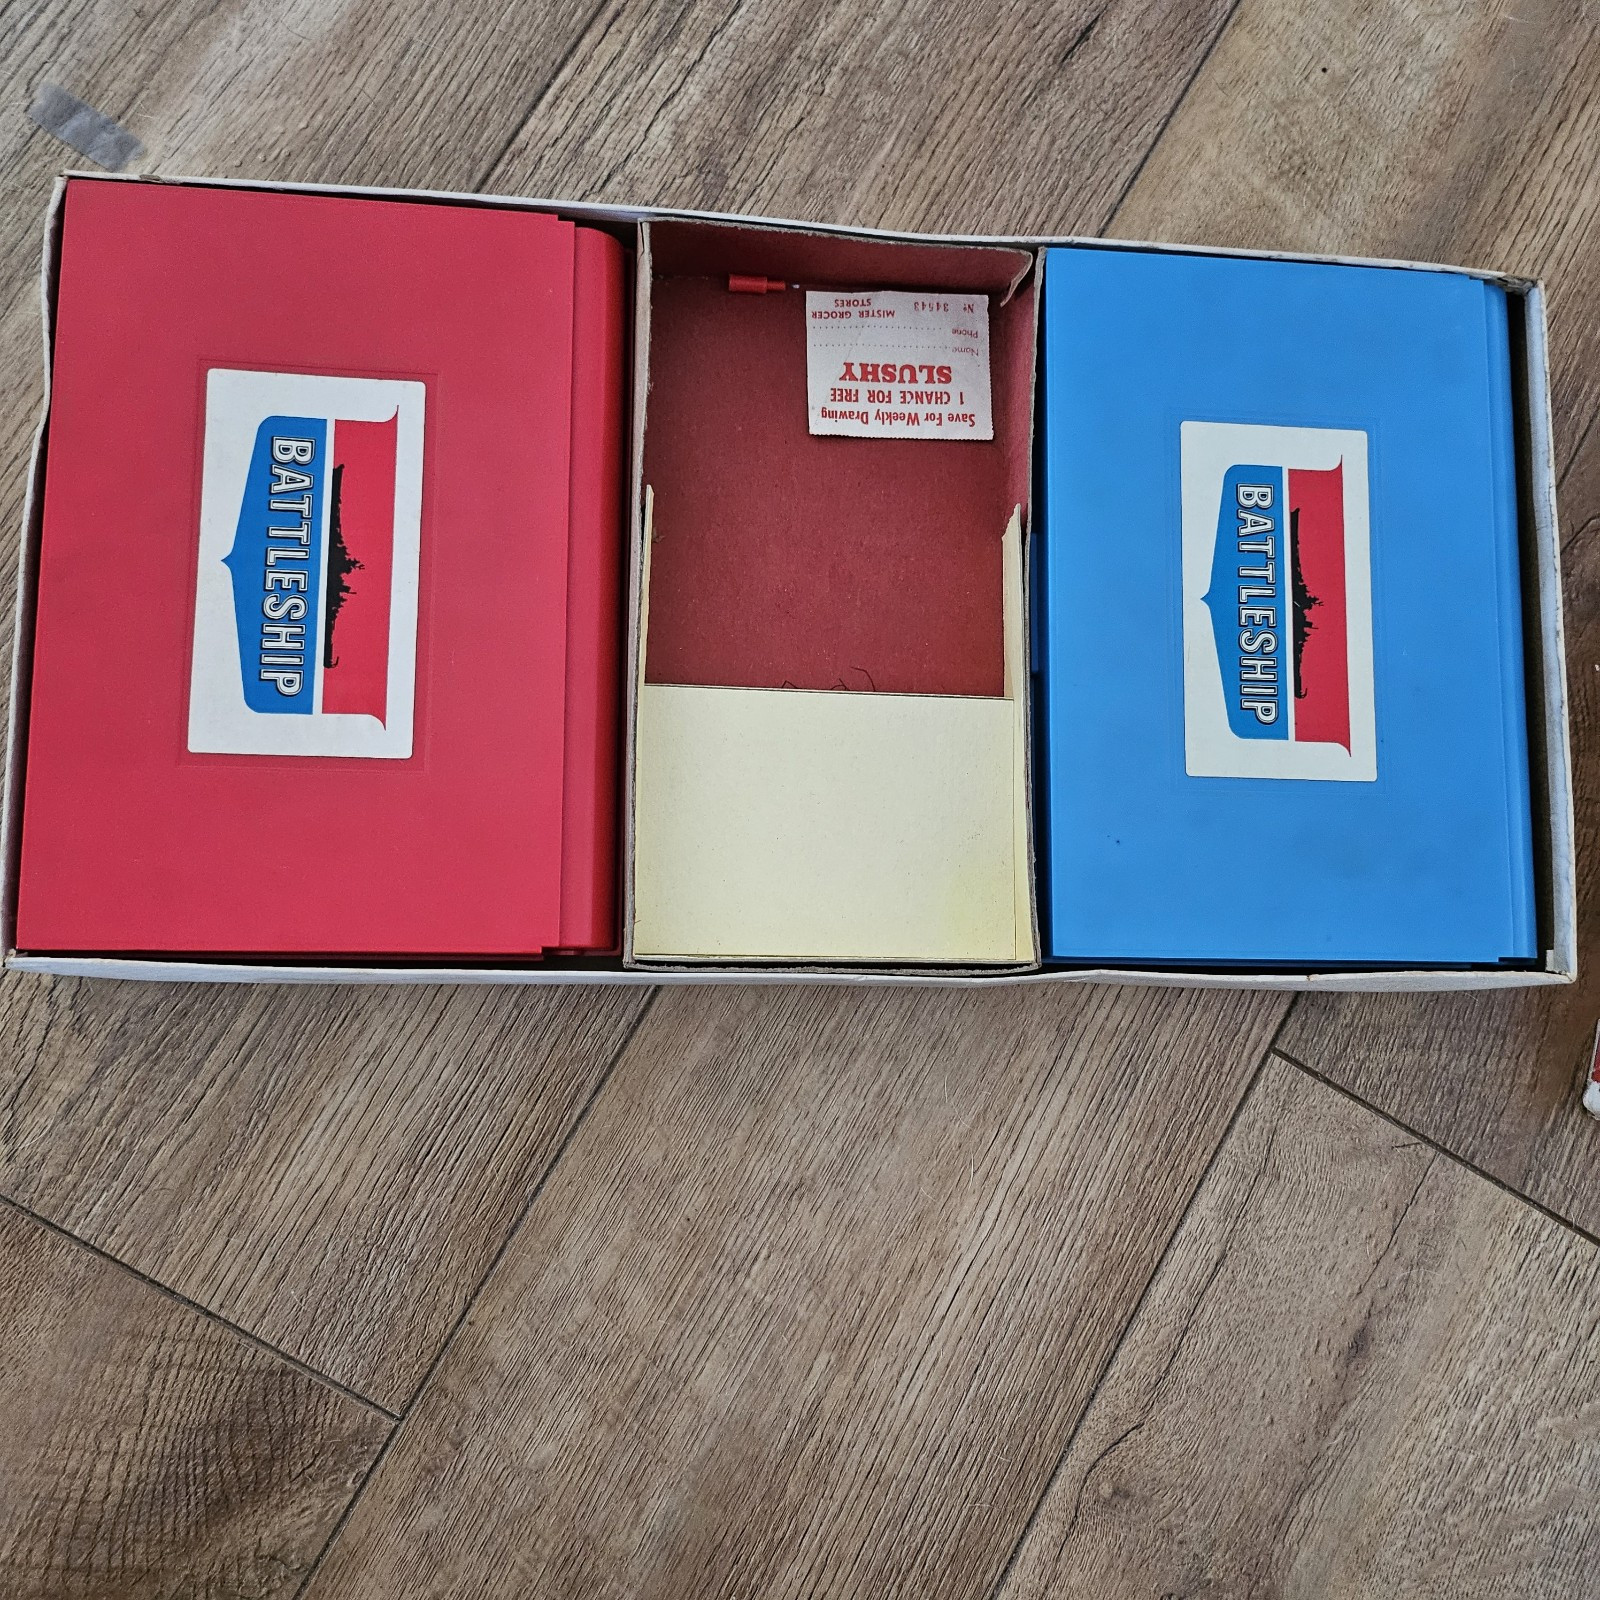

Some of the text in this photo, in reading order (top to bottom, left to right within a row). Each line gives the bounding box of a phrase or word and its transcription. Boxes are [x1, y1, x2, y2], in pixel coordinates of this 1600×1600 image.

[834, 298, 872, 308] STORES
[811, 309, 896, 319] MISTER GROCER
[951, 327, 979, 338] Phone
[838, 362, 953, 384] SLUSHY
[830, 387, 965, 405] 1 CHANCE FOR FREE
[821, 406, 976, 428] Save For Weekly Drawing
[258, 435, 316, 697] BATTLESHIP
[1236, 483, 1279, 725] BATTLESHIP
